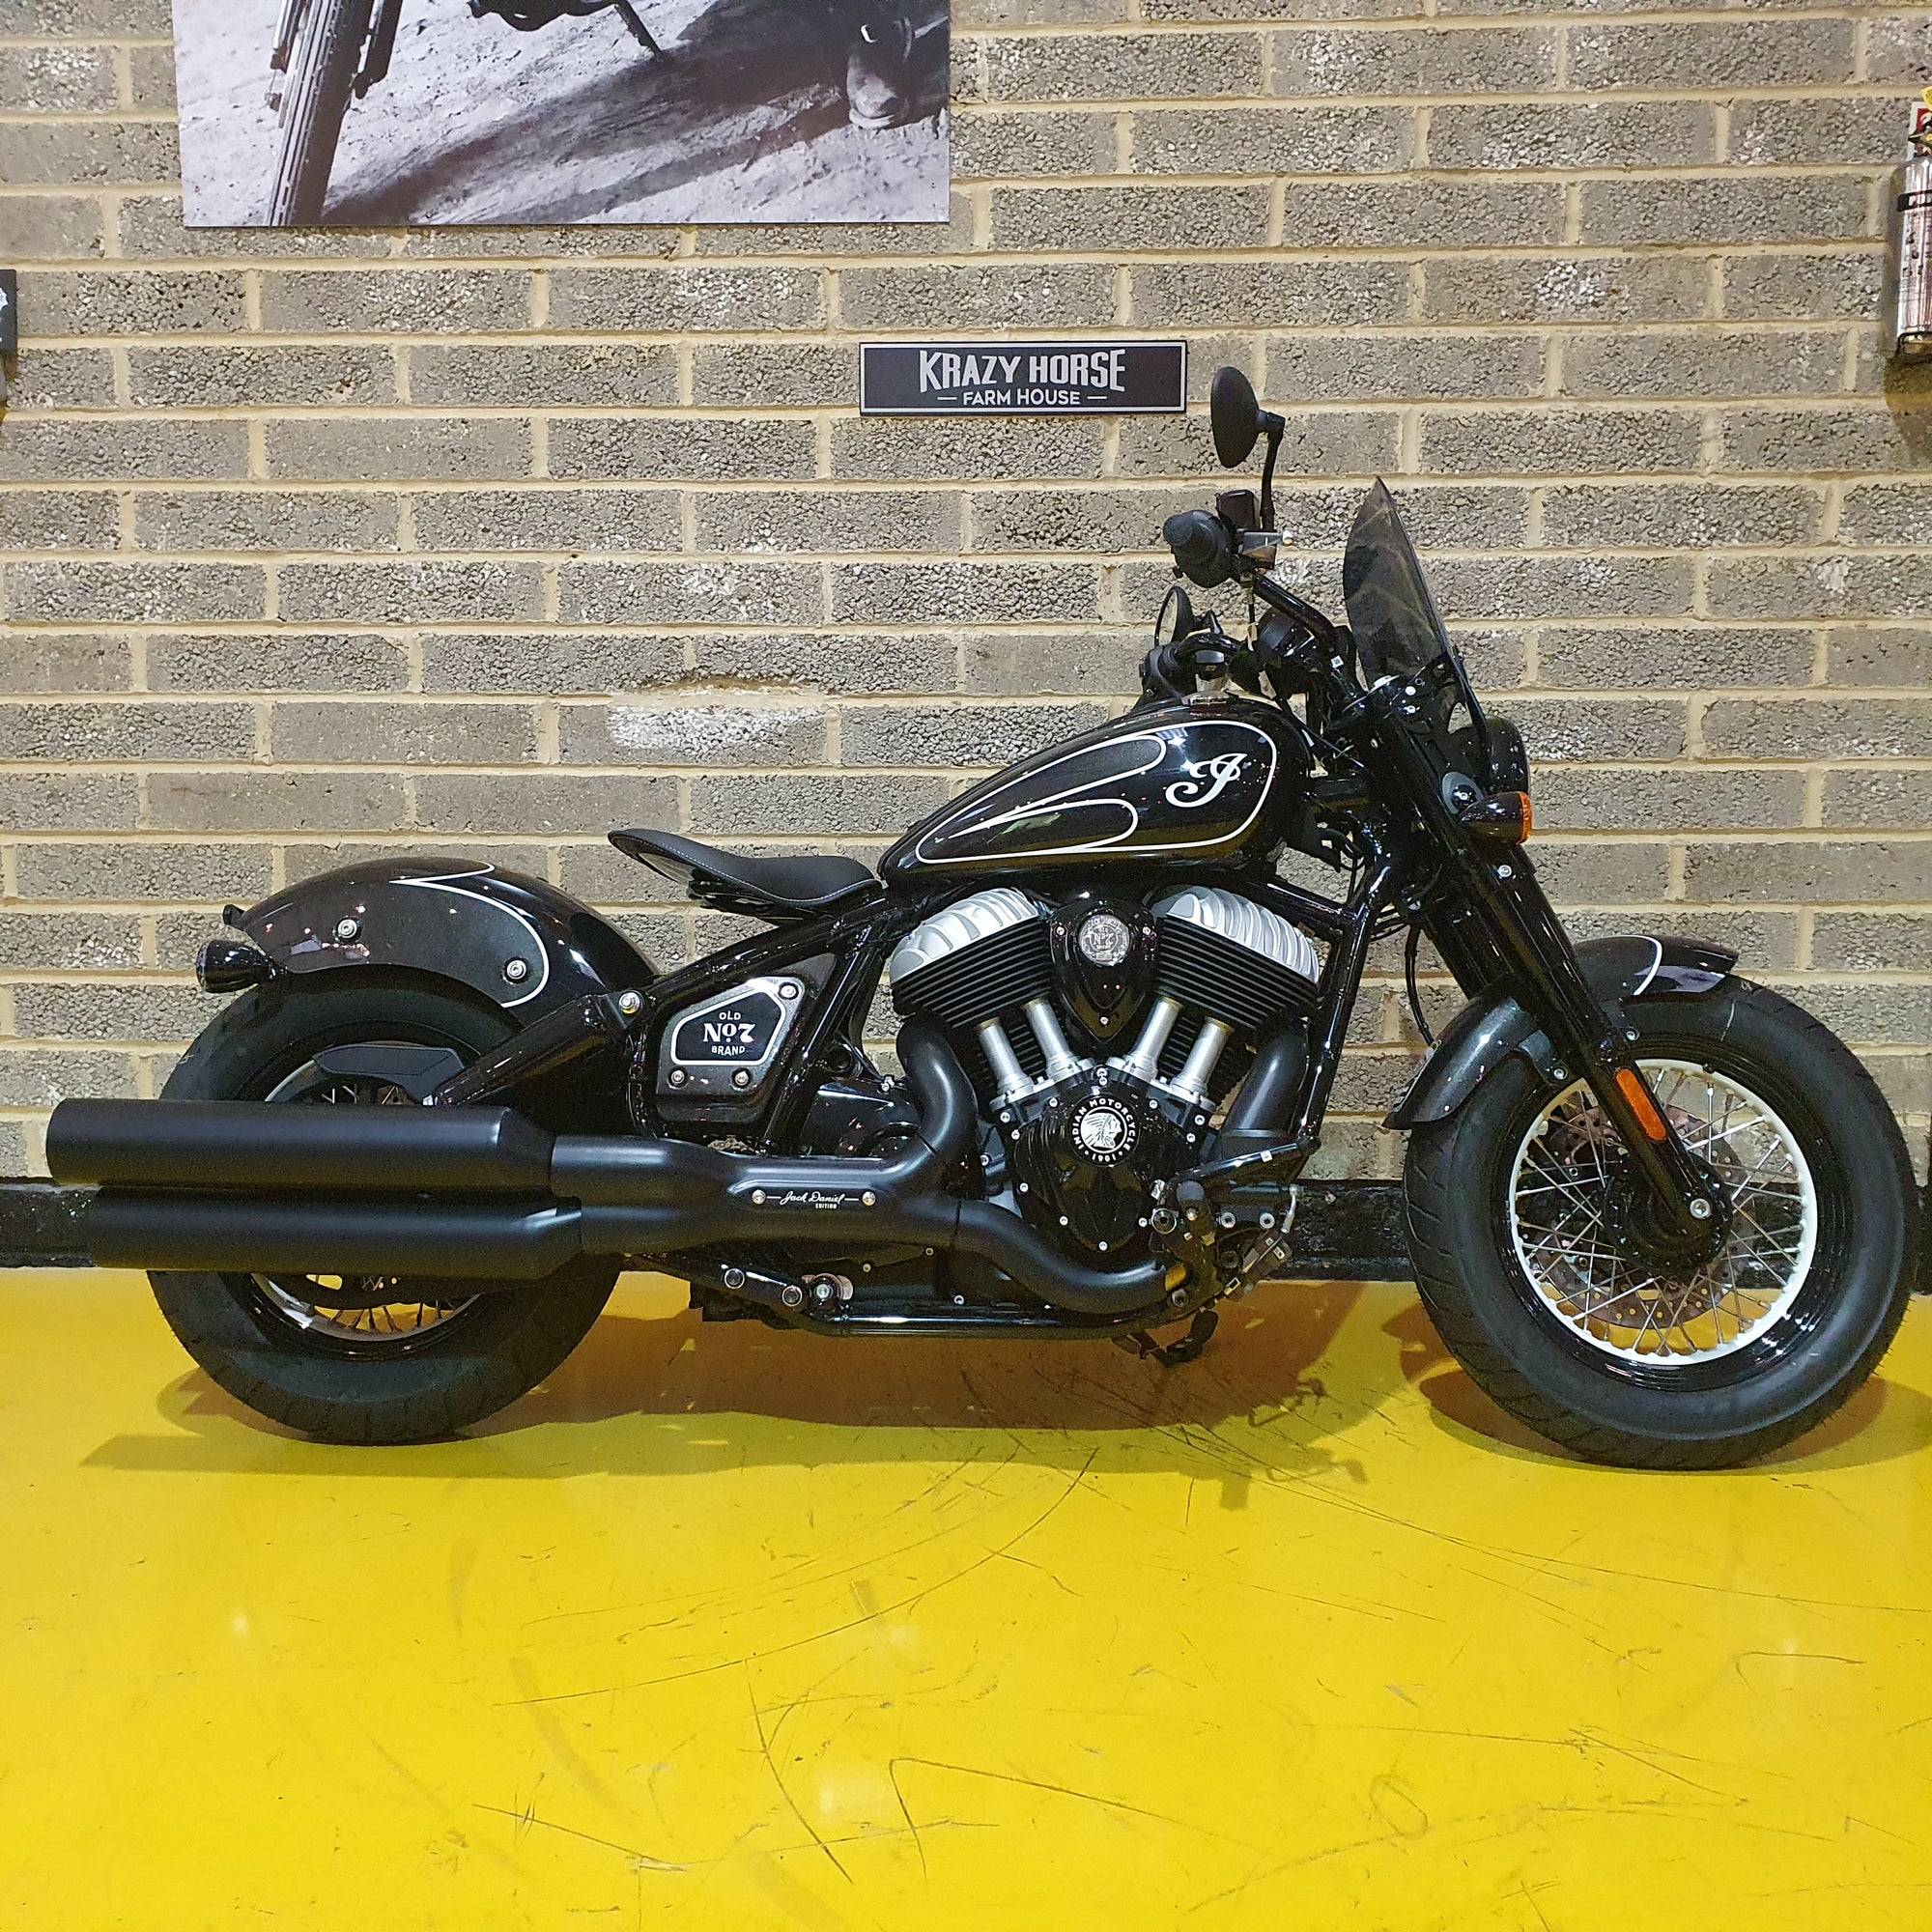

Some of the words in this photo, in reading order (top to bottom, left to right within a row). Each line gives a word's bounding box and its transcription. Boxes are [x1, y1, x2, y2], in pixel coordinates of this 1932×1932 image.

[920, 350, 1021, 393] KRAZY
[1029, 349, 1125, 392] HORSE
[963, 391, 1011, 406] FARM
[1016, 389, 1081, 405] HOUSE
[719, 1010, 742, 1020] OLD
[711, 1045, 746, 1056] BRAND
[1072, 1106, 1088, 1150] INDIAN
[1090, 1097, 1136, 1151] MOTORCYCLE
[1092, 1153, 1117, 1162] 1901
[780, 1190, 808, 1205] Jack
[809, 1191, 845, 1205] Daniel
